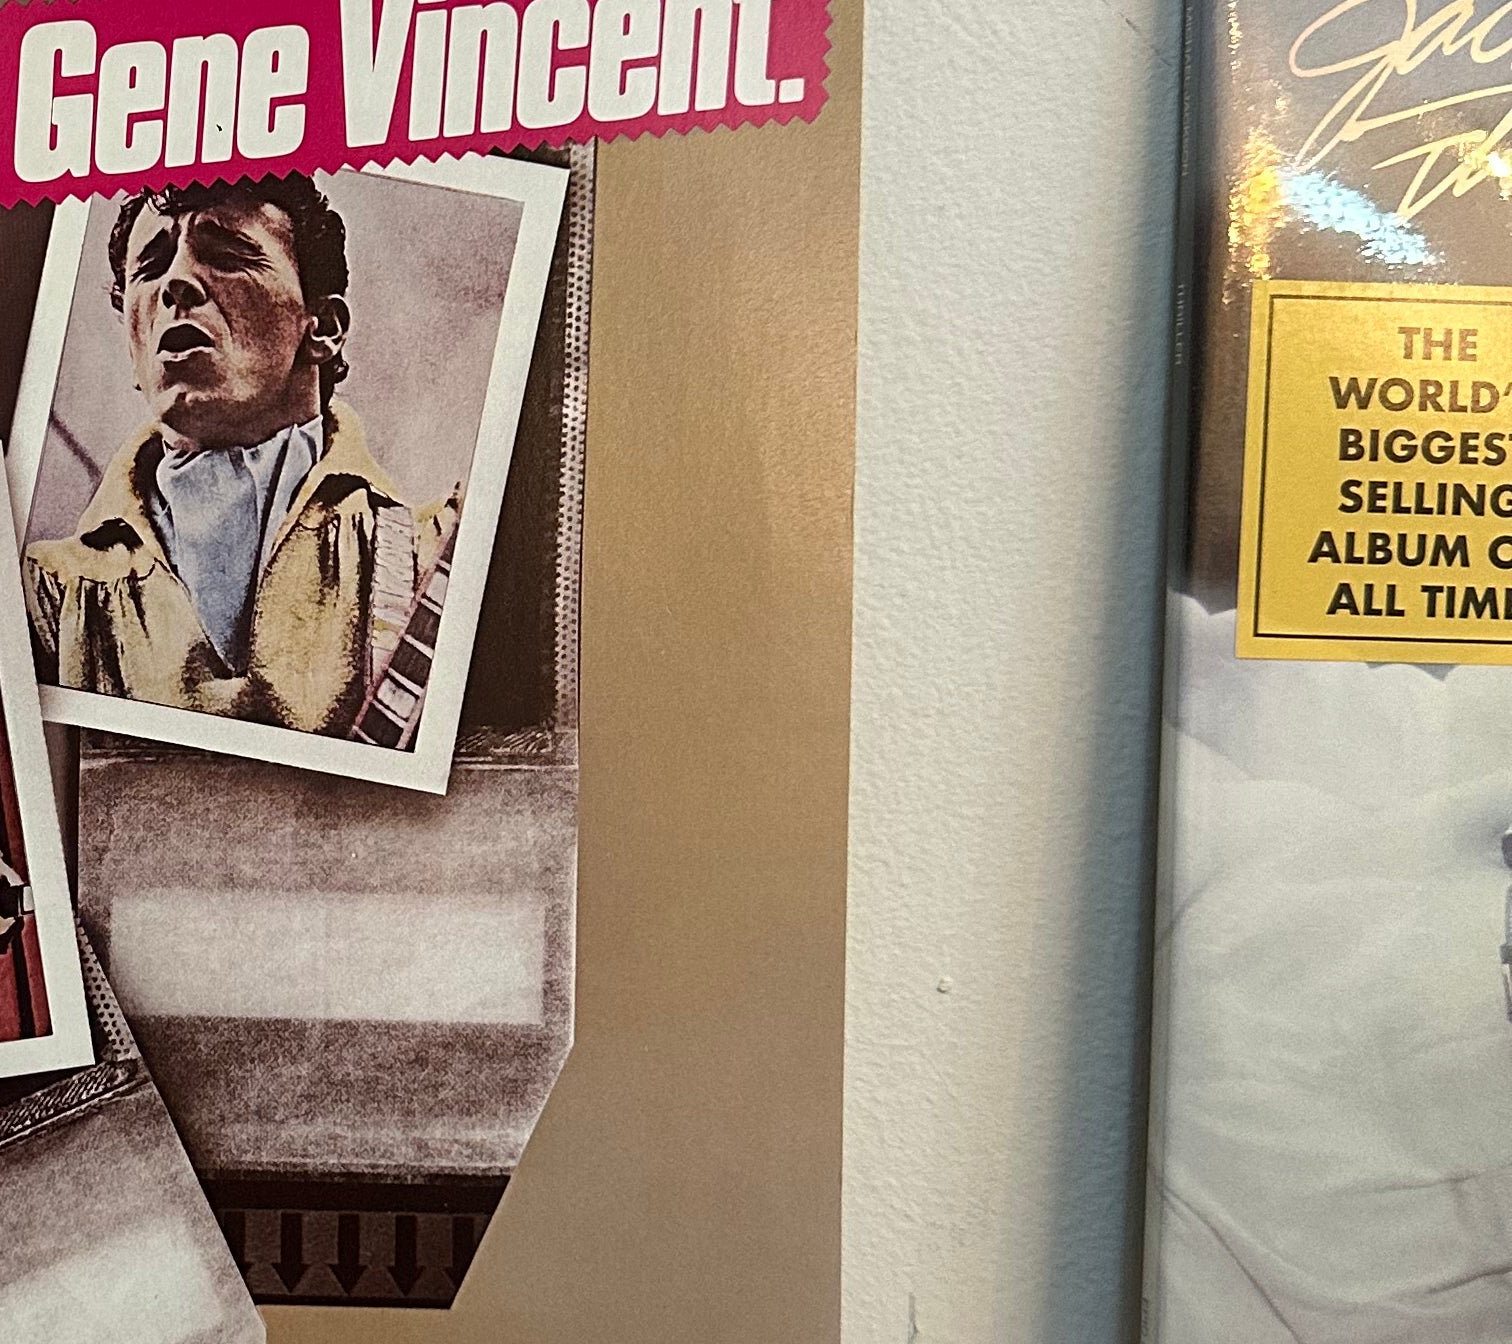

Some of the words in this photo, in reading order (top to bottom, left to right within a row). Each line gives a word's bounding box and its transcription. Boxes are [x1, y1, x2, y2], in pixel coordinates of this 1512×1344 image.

[11, 19, 311, 186] Gene
[1397, 325, 1479, 362] THE
[1339, 427, 1512, 467] BIGGES
[1307, 530, 1470, 568] ALBUM
[1326, 582, 1406, 617] ALL
